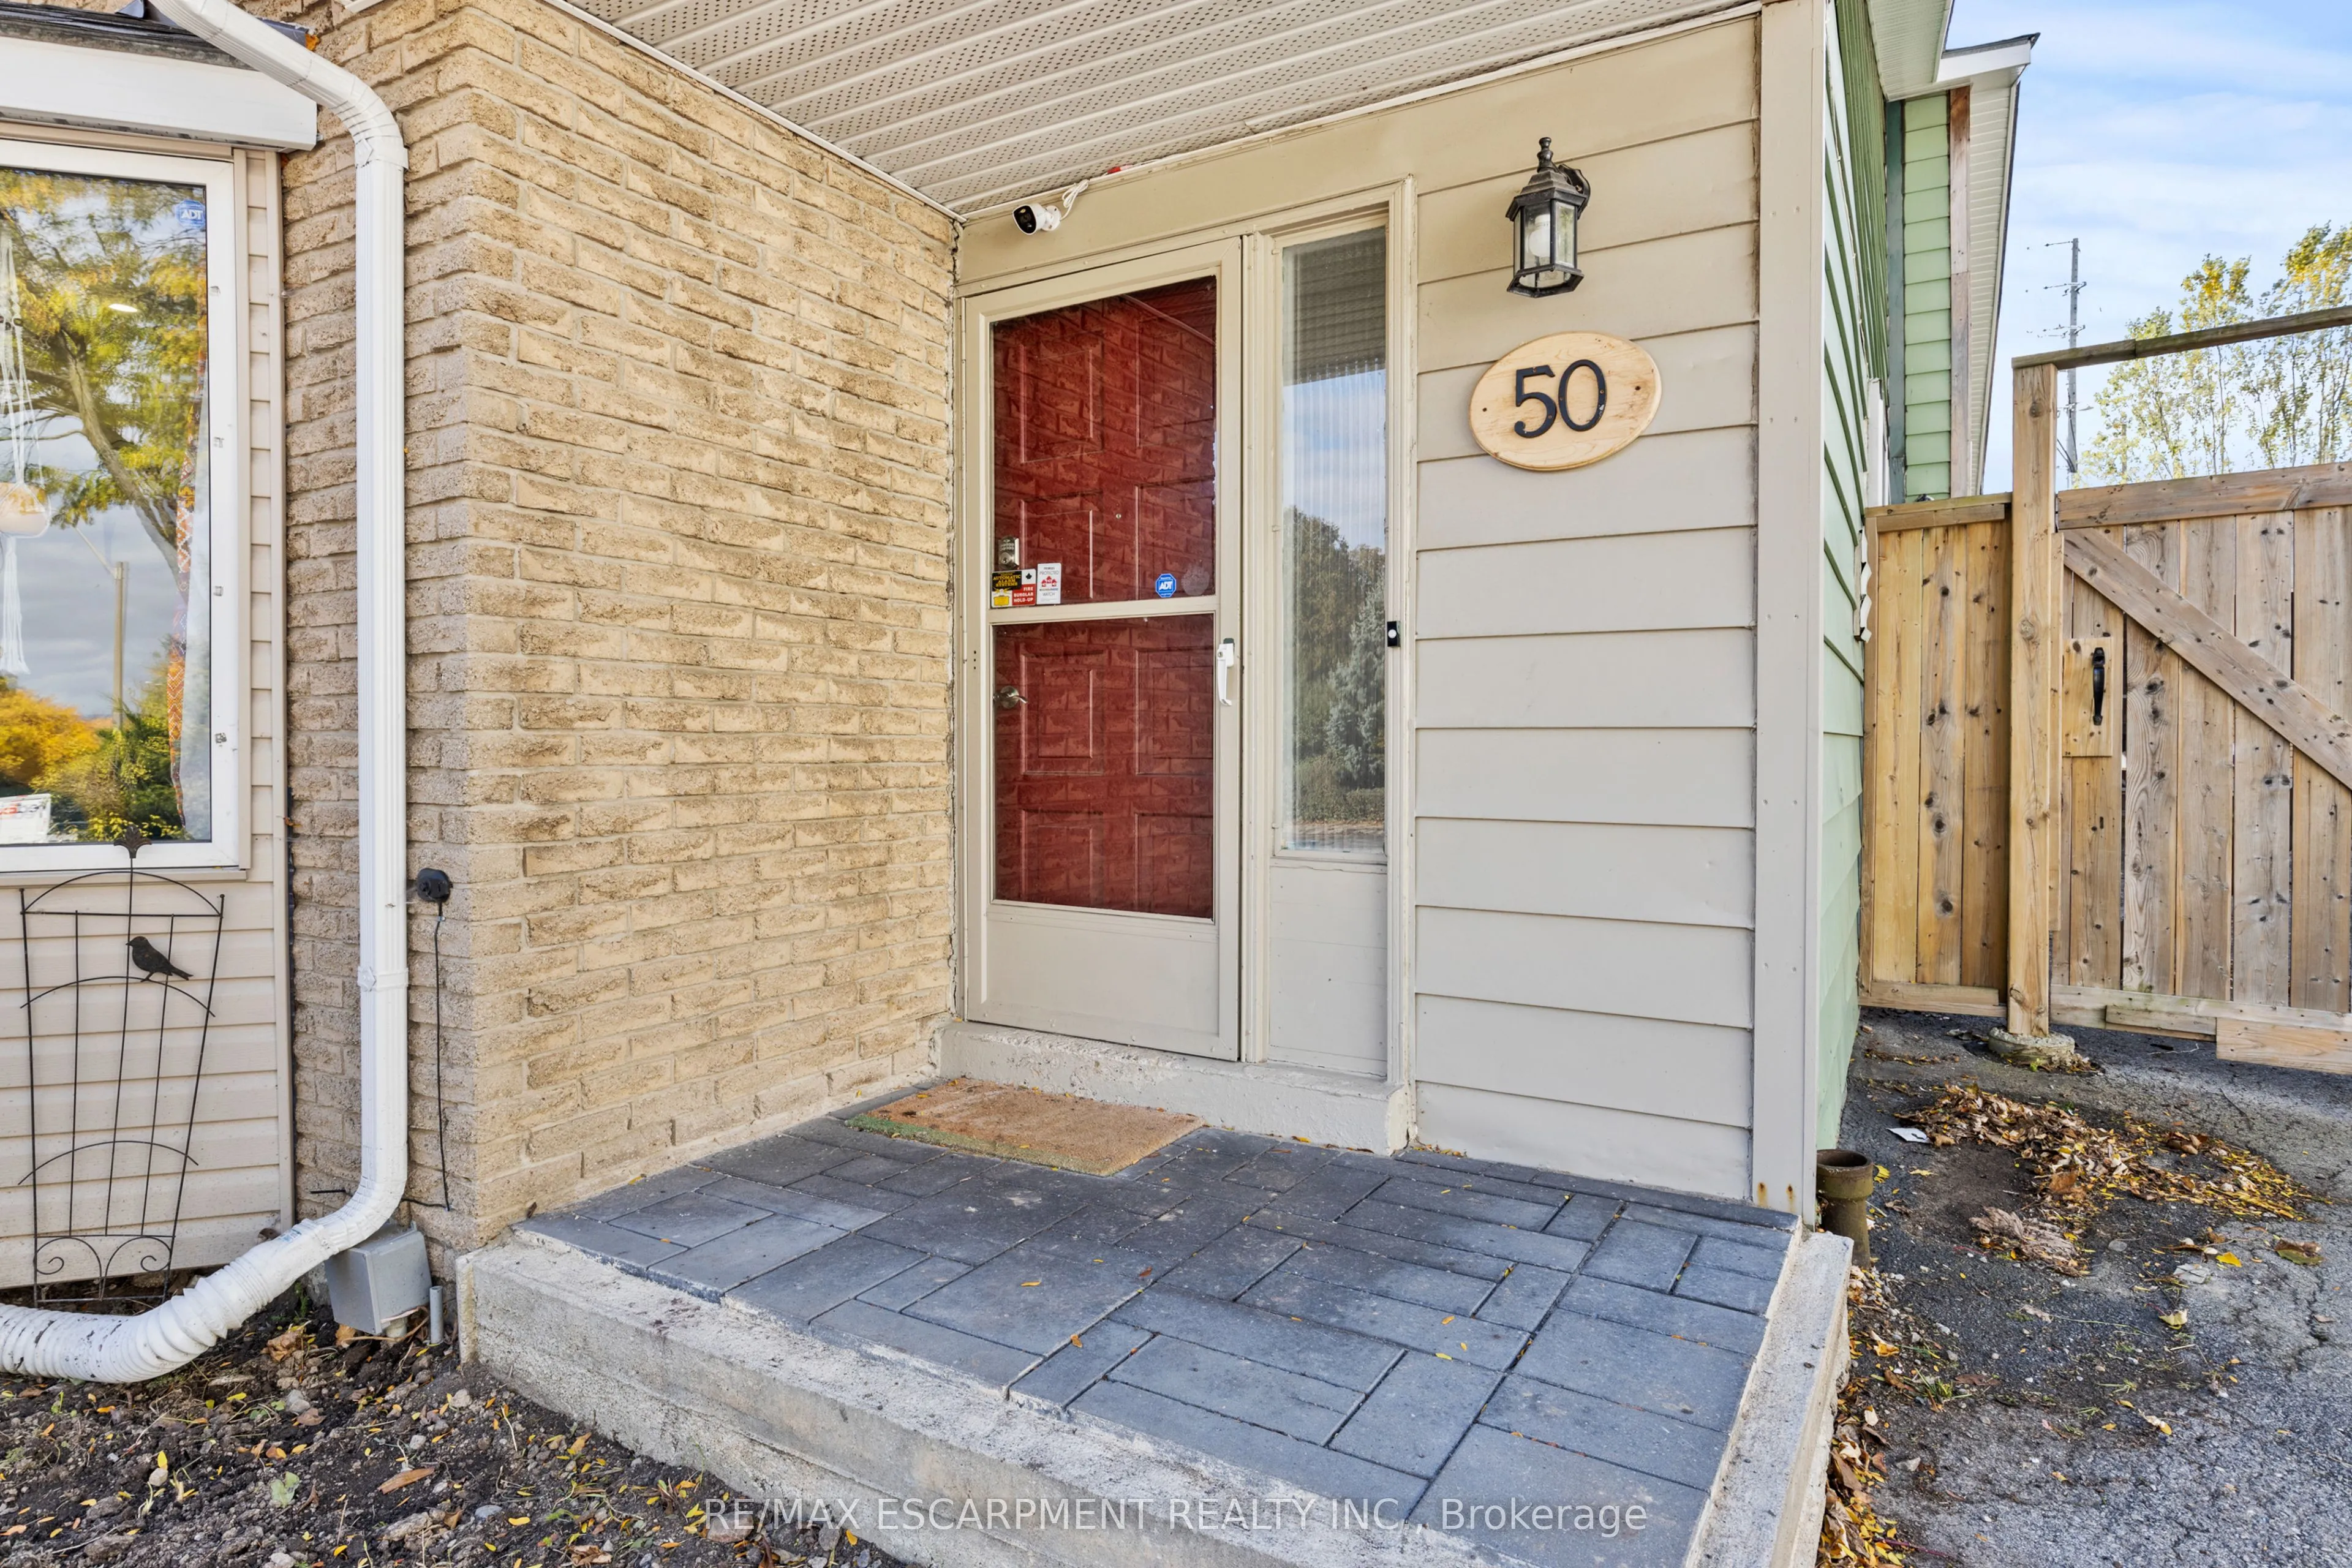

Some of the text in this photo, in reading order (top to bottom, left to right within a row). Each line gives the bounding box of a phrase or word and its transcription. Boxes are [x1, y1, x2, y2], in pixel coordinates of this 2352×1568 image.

[181, 209, 203, 220] ADT
[1514, 360, 1607, 438] 50
[1159, 581, 1173, 590] ADT
